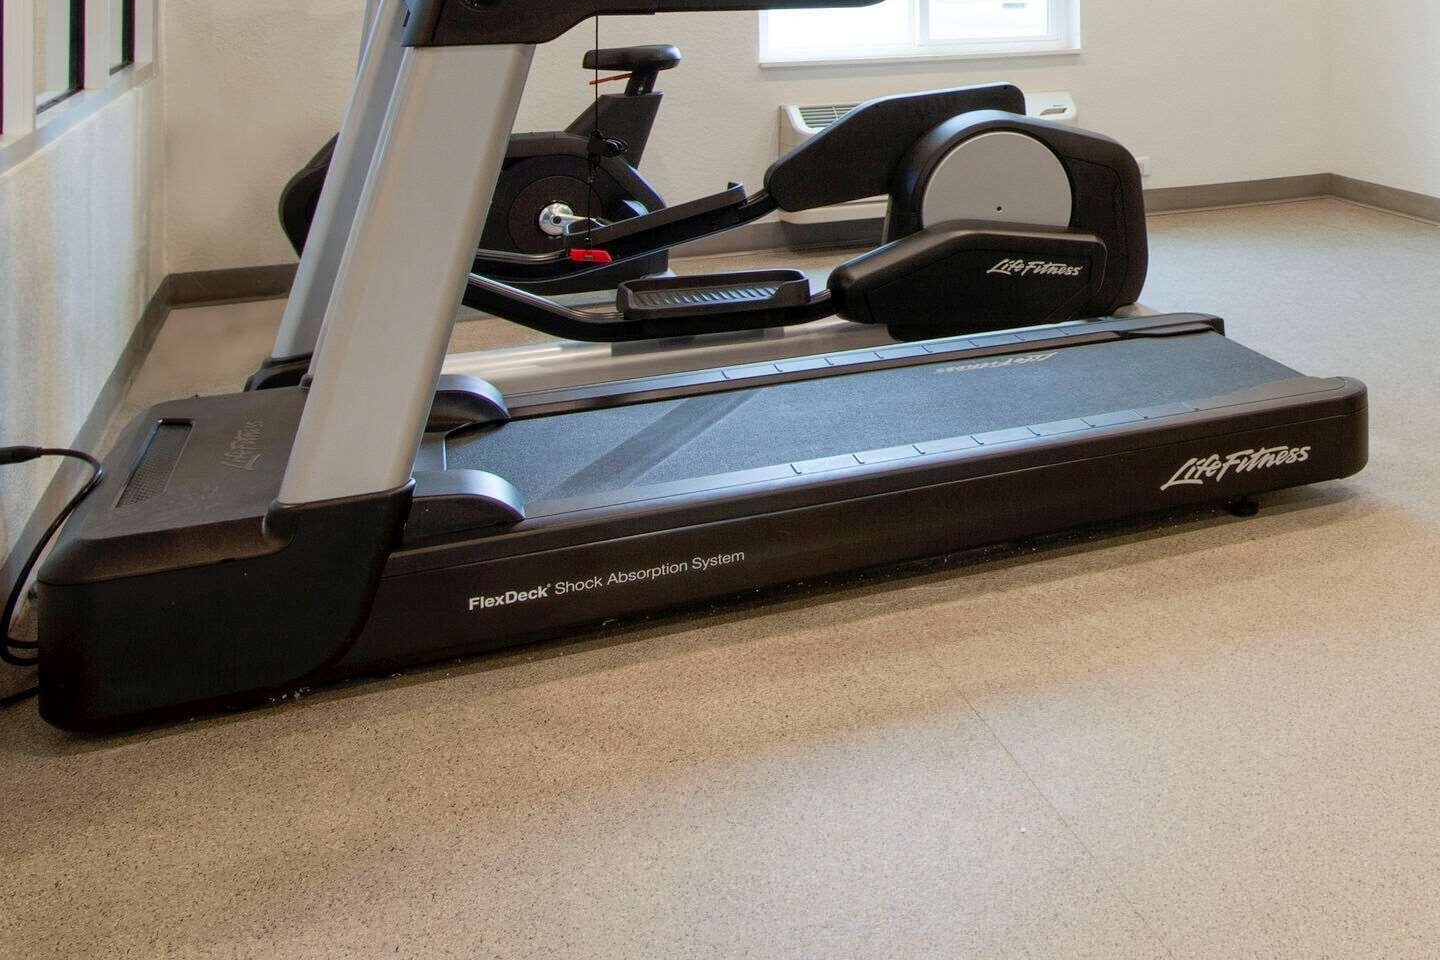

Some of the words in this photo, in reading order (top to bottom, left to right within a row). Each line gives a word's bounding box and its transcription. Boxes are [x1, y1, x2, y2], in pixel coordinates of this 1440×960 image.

[554, 575, 603, 596] Shock
[606, 562, 689, 586] Absorption
[691, 551, 746, 571] System
